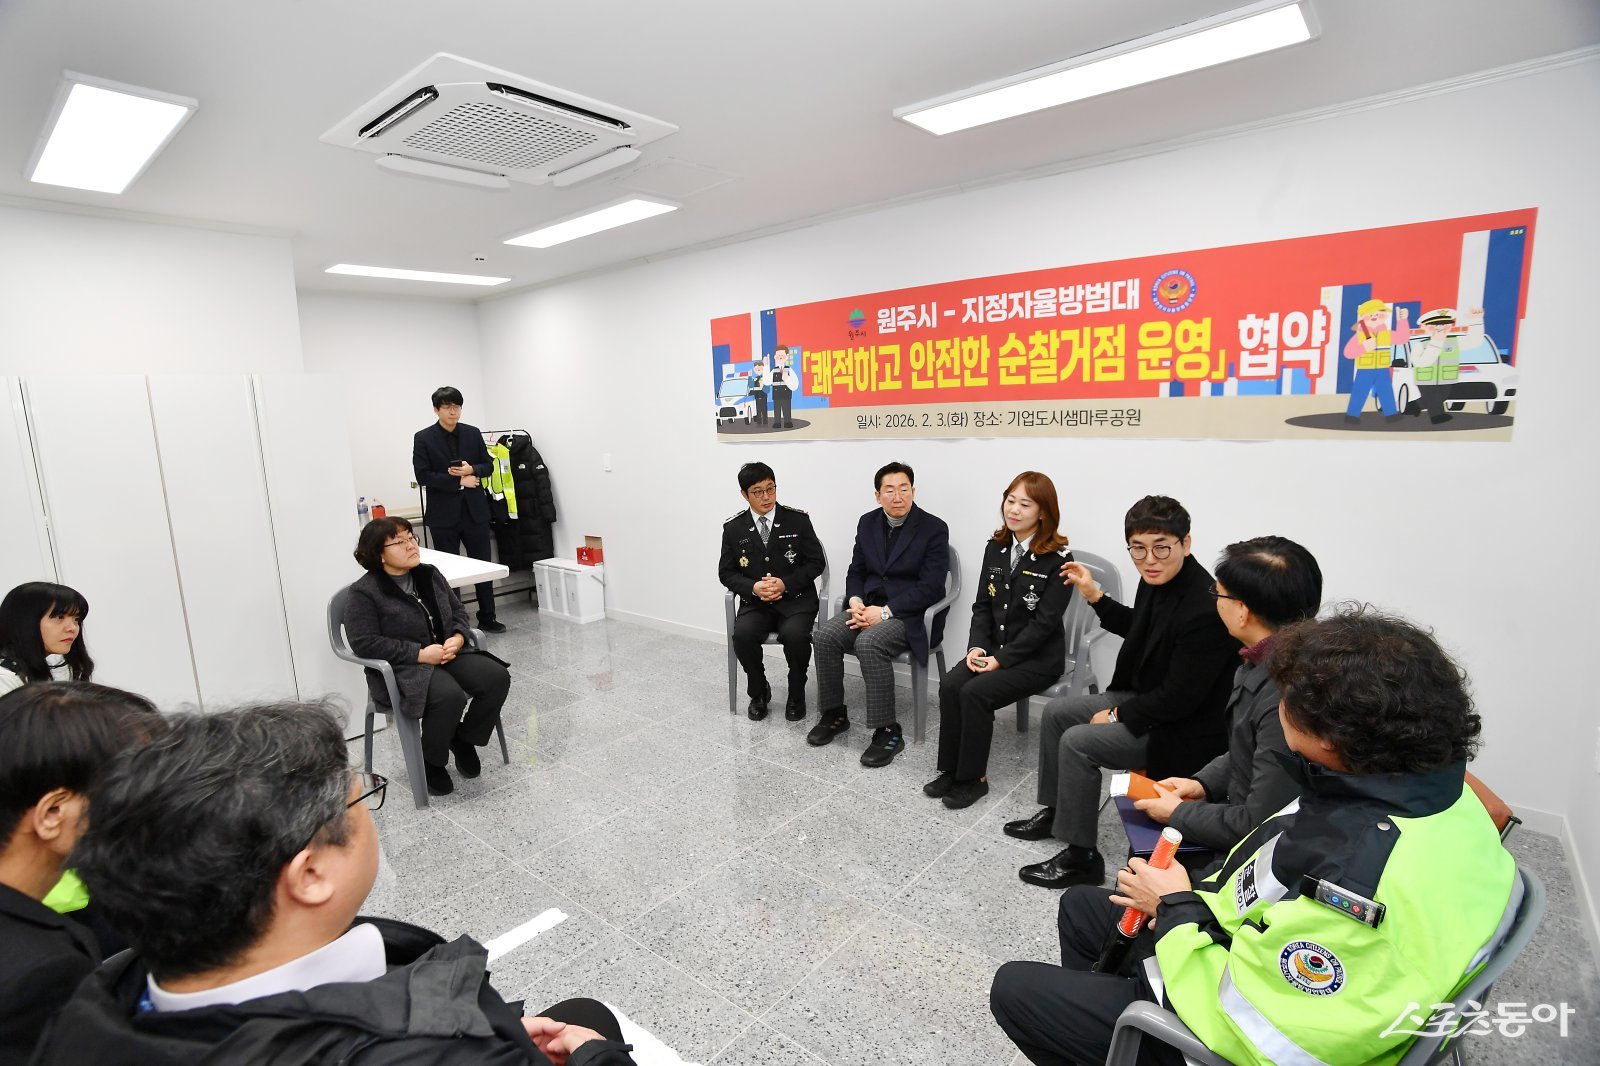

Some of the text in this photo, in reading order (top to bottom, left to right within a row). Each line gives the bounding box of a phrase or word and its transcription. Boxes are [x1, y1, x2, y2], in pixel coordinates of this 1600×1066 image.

[877, 302, 937, 334] 원주시
[961, 278, 1140, 324] 지정자율방범대
[848, 330, 867, 341] 원주시
[909, 335, 990, 390] 안전한
[998, 324, 1126, 385] 순찰거점
[1238, 309, 1327, 377] 협약
[856, 408, 1141, 430] 일시: 2026. 2. 3.(화) 장소: 기업도시샘마루공원
[1305, 942, 1332, 959] CITIZENS
